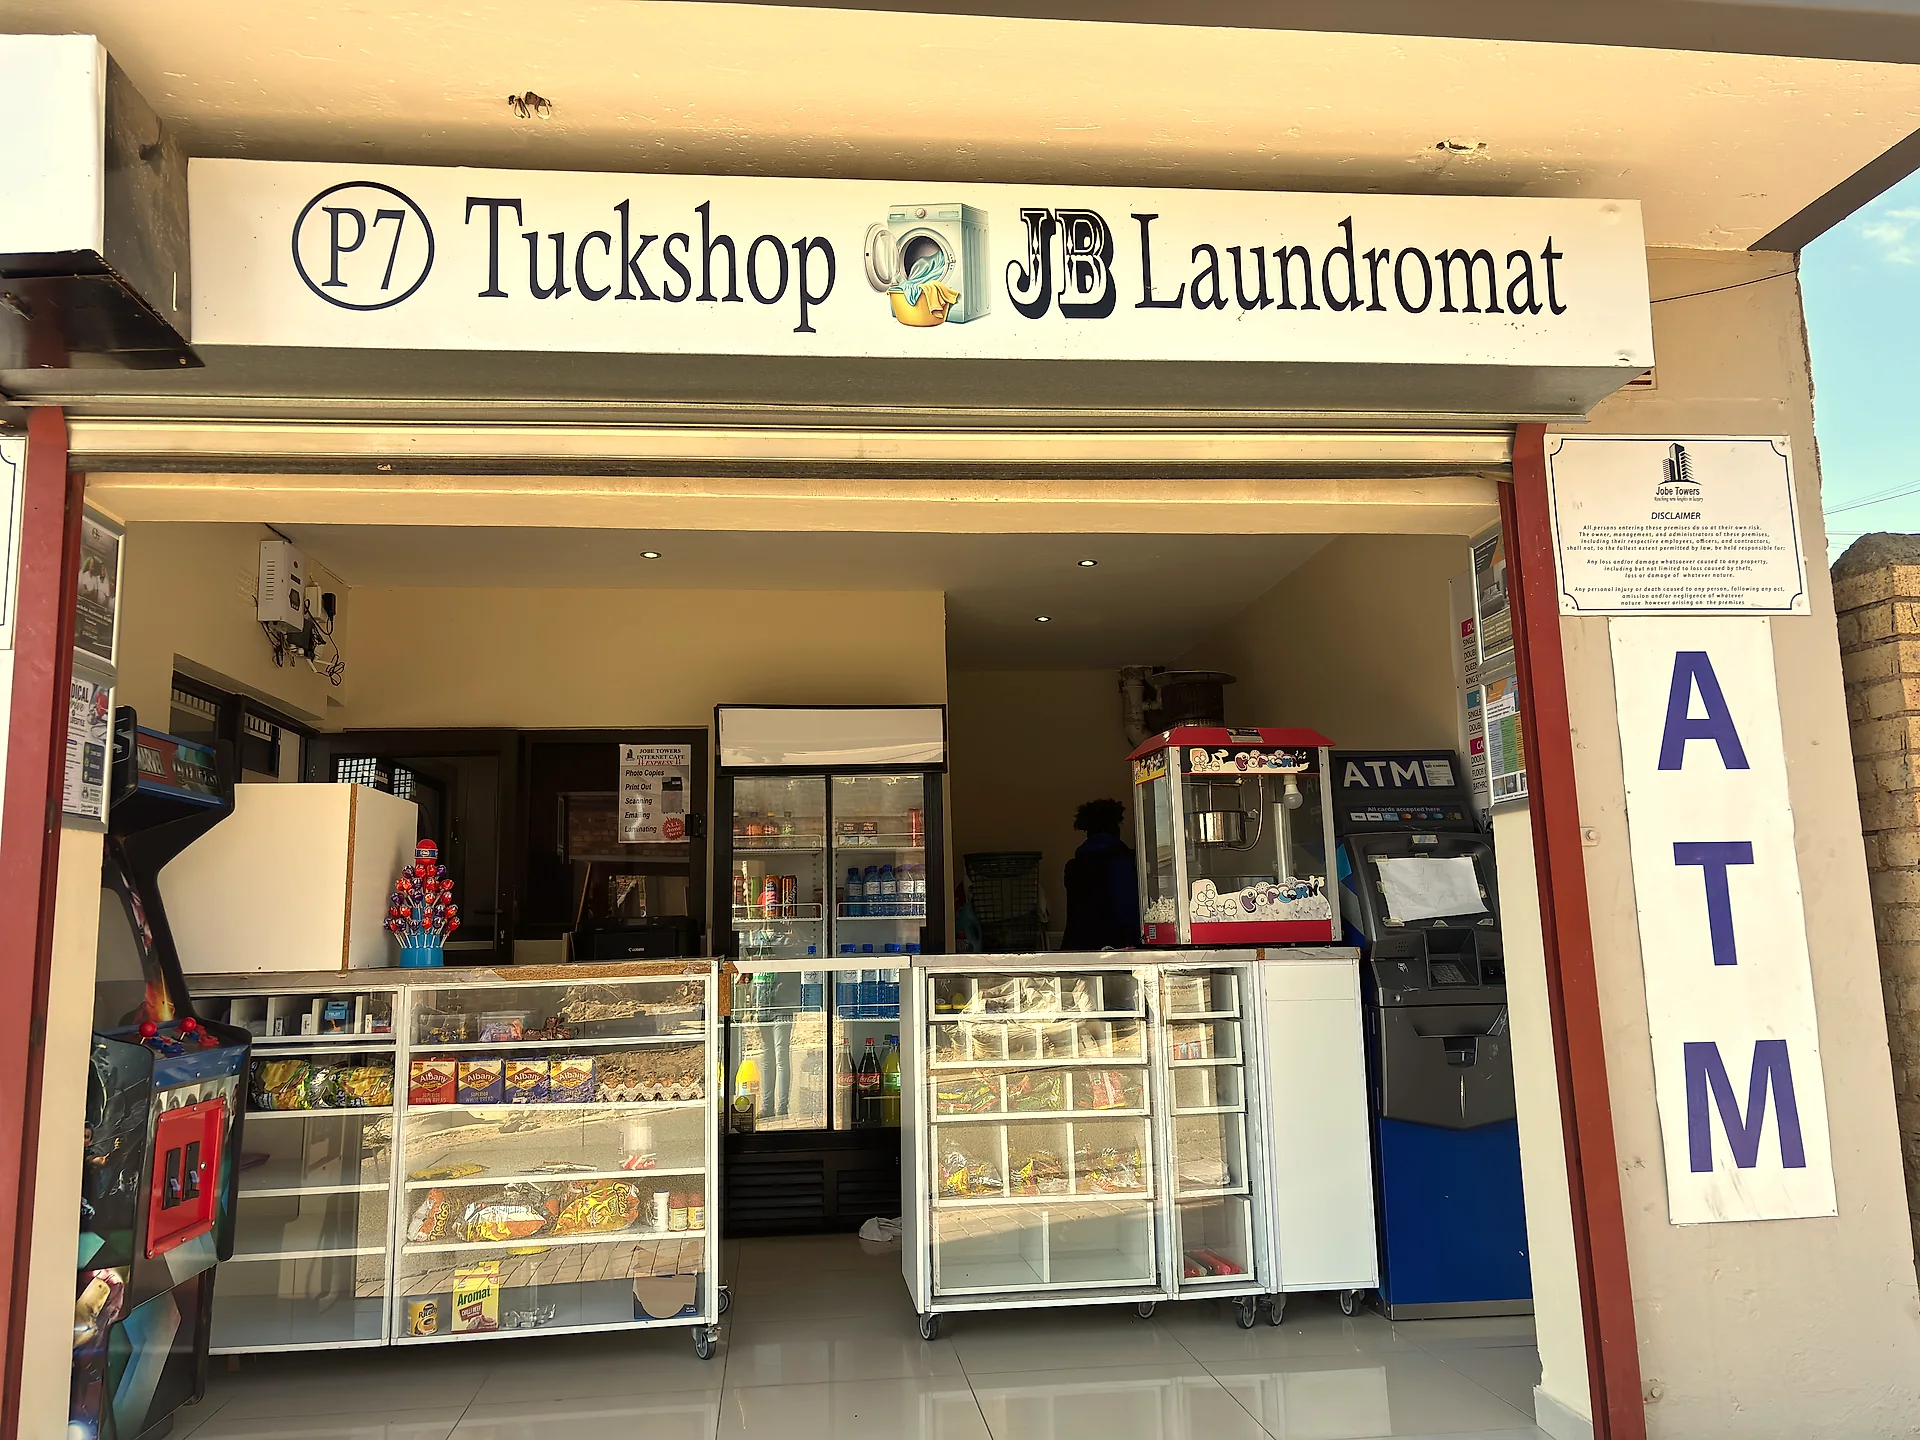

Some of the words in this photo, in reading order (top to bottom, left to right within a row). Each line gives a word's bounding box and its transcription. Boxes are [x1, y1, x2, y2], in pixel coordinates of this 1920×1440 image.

[321, 205, 406, 291] P7
[464, 196, 837, 334] Tuckshop
[1005, 207, 1116, 320] JB
[1130, 213, 1568, 316] Laundromat
[1655, 486, 1673, 496] Jobe
[1674, 486, 1700, 496] Towers
[1651, 511, 1701, 520] DISCLAIMER
[625, 769, 643, 777] Photo
[644, 769, 665, 777] Copies
[1343, 761, 1425, 788] ATM
[625, 783, 640, 791] Print
[640, 783, 652, 791] Out
[1240, 880, 1319, 914] POPCORN
[1658, 651, 1806, 1172] ATM
[420, 1073, 448, 1083] Albany
[467, 1073, 494, 1082] Albany
[514, 1073, 541, 1082] Albany
[560, 1072, 586, 1081] Albany
[457, 1286, 491, 1307] Aromat
